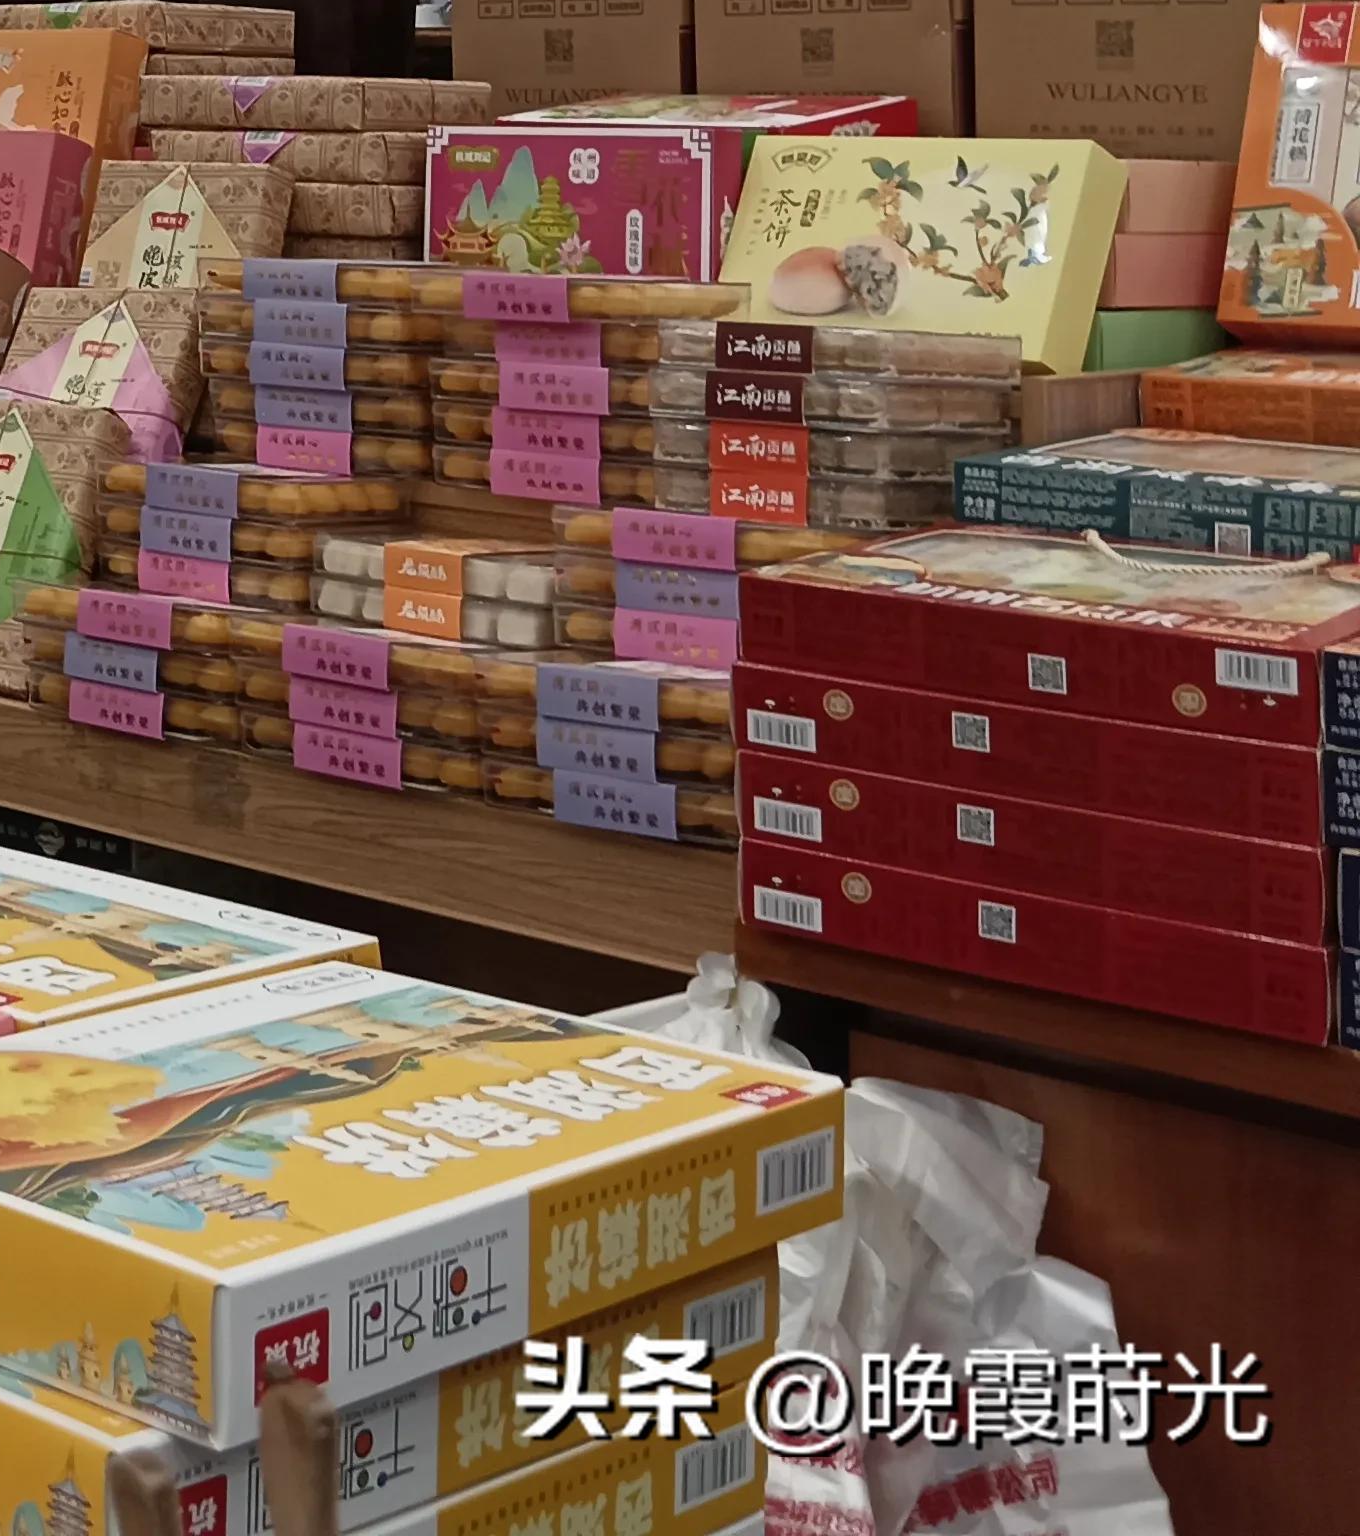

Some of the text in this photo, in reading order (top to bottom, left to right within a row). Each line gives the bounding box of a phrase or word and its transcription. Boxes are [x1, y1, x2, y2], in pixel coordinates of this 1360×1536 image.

[1046, 82, 1208, 104] WULIANGYE
[543, 1166, 738, 1307] 西湖藕饼
